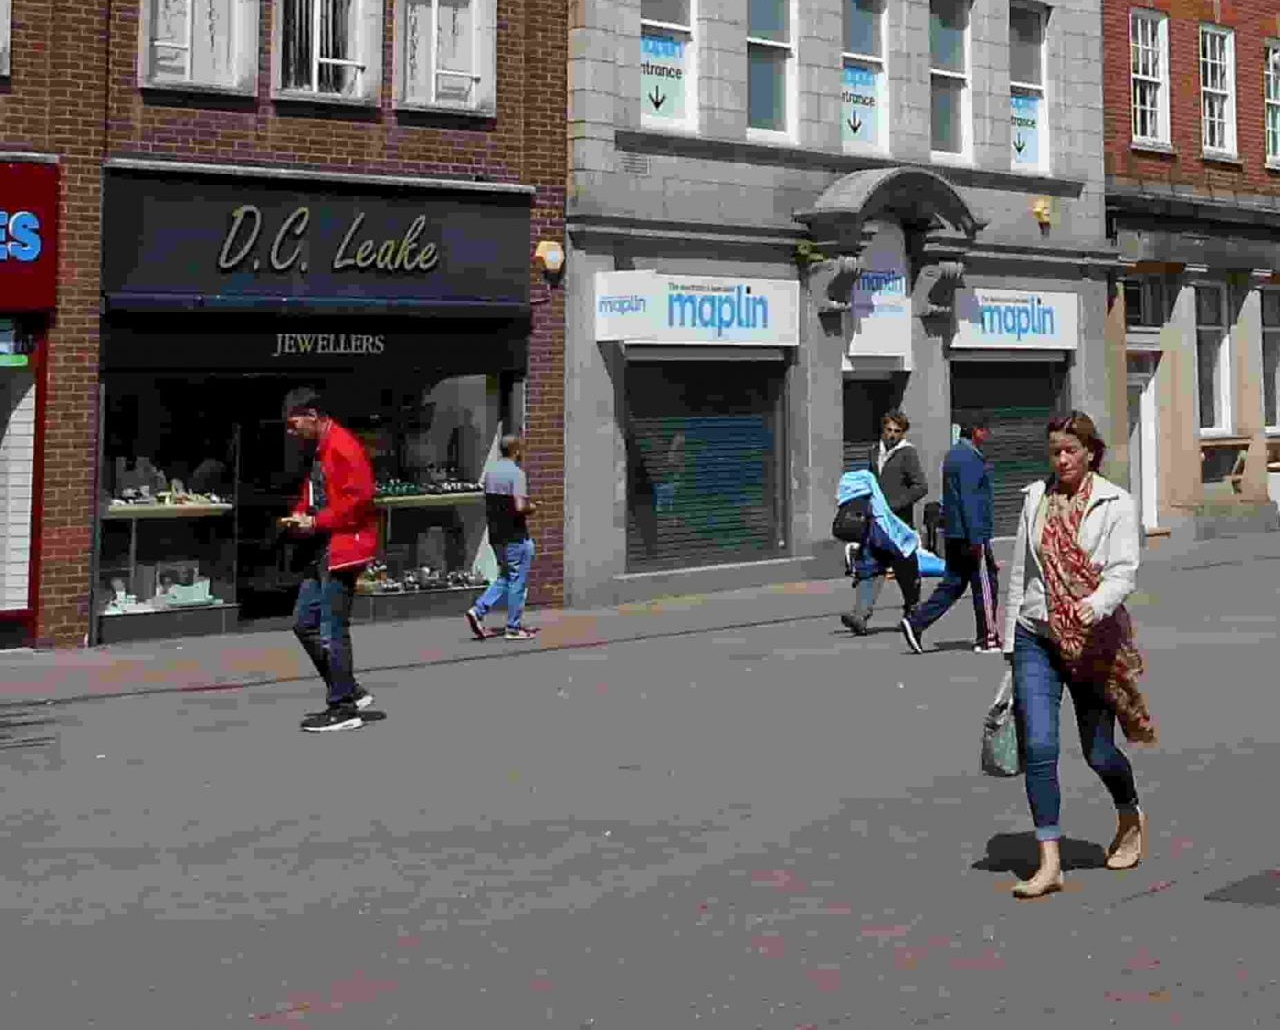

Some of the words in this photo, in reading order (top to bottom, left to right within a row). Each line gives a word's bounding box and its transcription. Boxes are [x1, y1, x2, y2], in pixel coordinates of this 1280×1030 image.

[640, 60, 683, 80] ntrance
[841, 91, 876, 107] trance
[0, 211, 41, 261] S
[334, 212, 438, 269] Leake
[599, 295, 646, 316] maplin
[668, 283, 768, 338] maplin
[981, 295, 1055, 341] maplin
[272, 334, 385, 356] JEWELLERS
